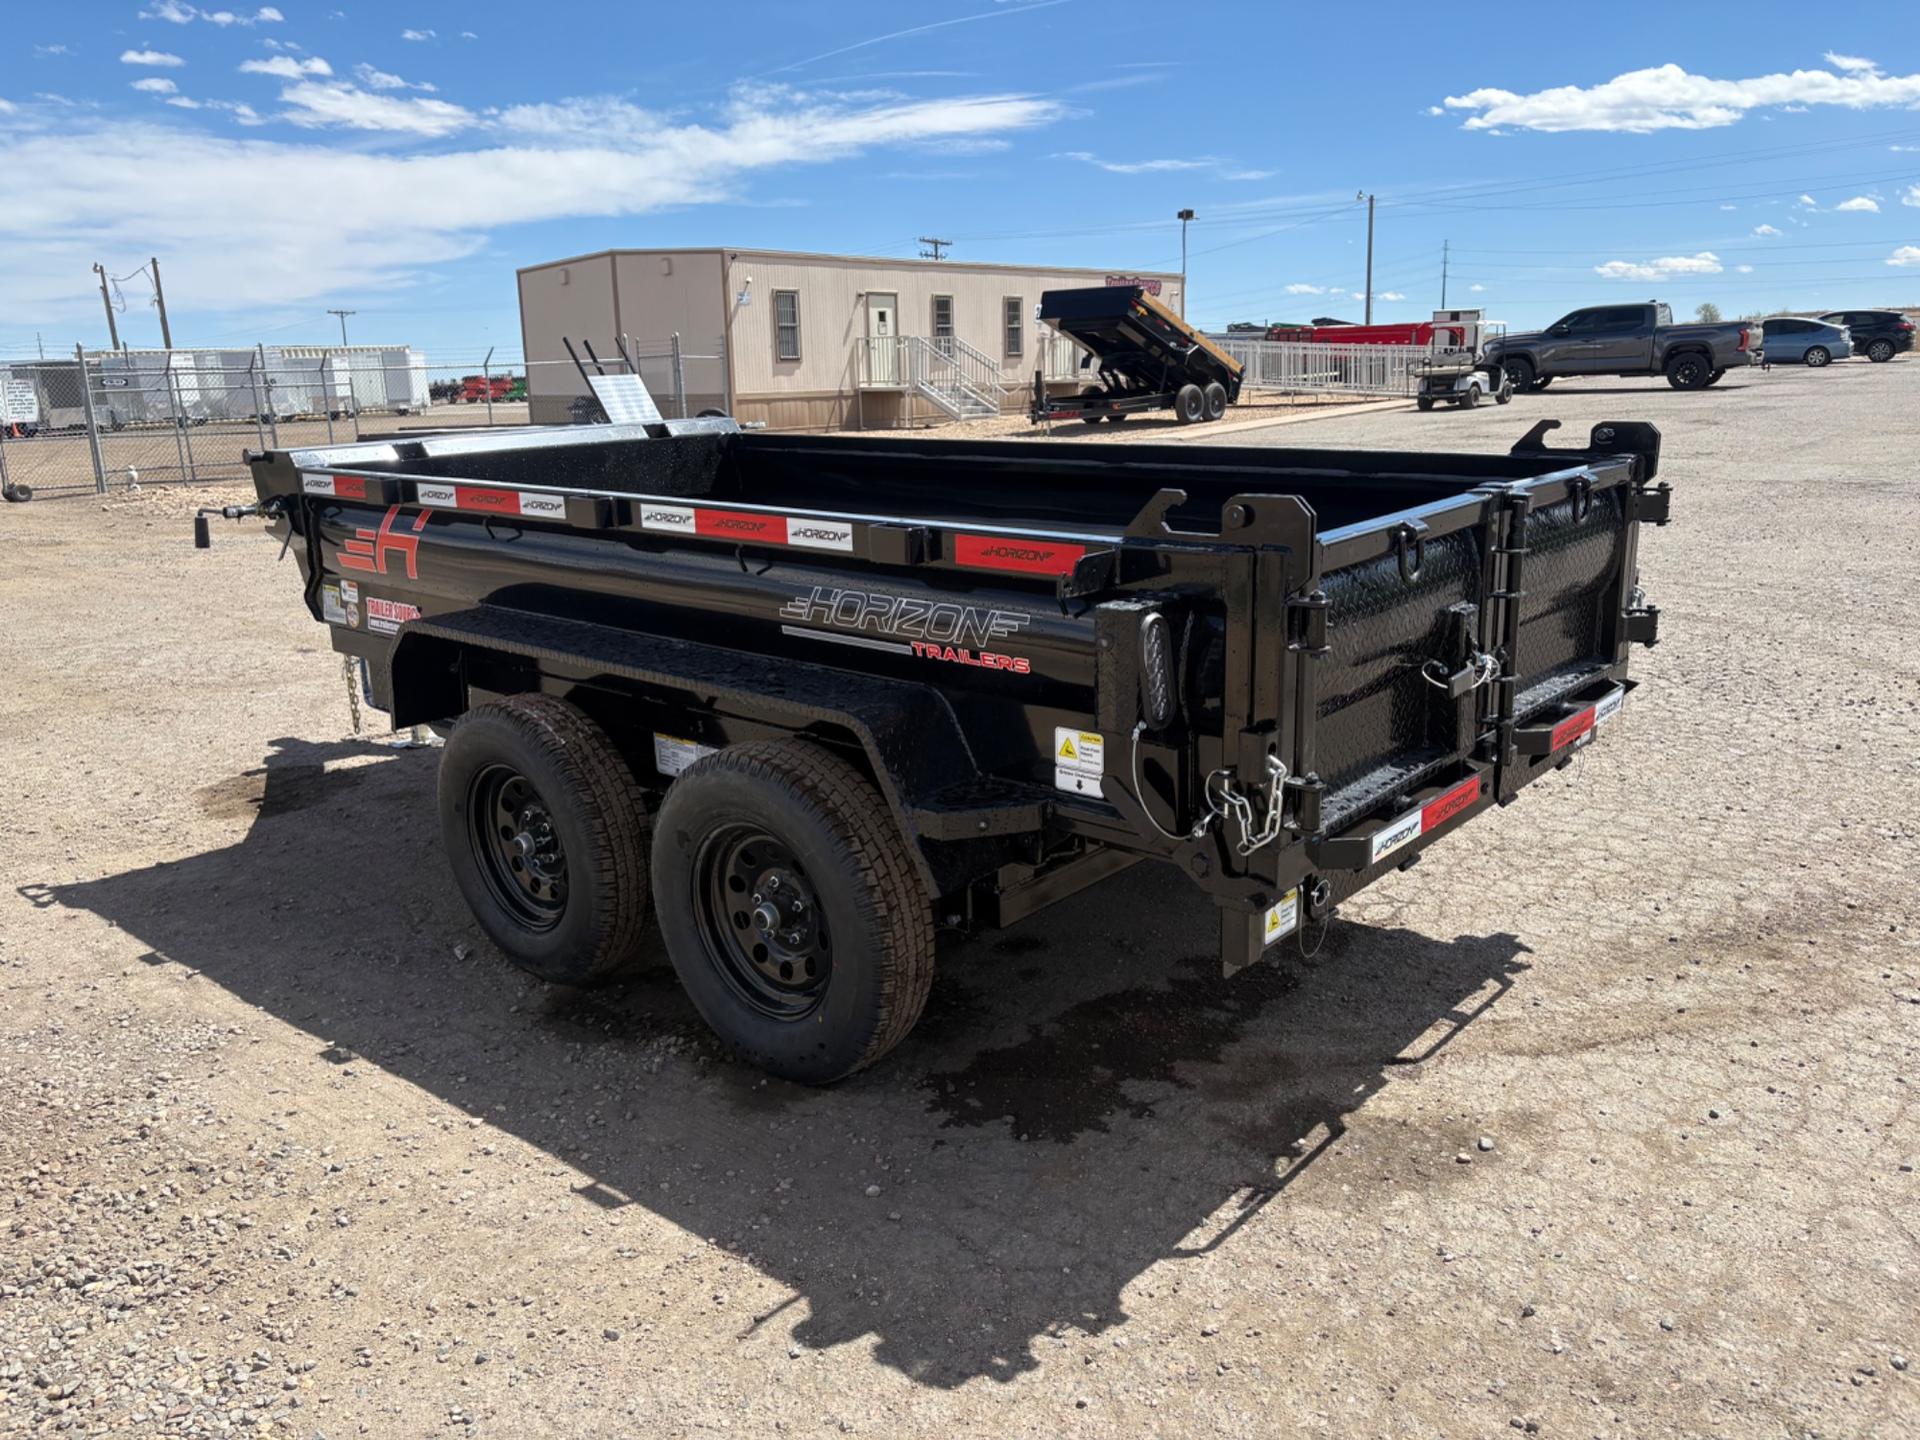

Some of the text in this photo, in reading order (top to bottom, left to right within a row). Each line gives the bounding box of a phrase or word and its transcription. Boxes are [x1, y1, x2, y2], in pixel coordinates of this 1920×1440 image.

[522, 500, 562, 511] HORIZON
[644, 511, 692, 525] HORIZON
[714, 519, 766, 532] HORIZON
[791, 527, 850, 542] HORIZON
[981, 545, 1055, 563] HORIZON
[367, 598, 394, 619] TRAILER
[779, 586, 1031, 648] HORIZON
[911, 641, 1031, 674] TRAILERS
[1375, 821, 1419, 857] HORIZON
